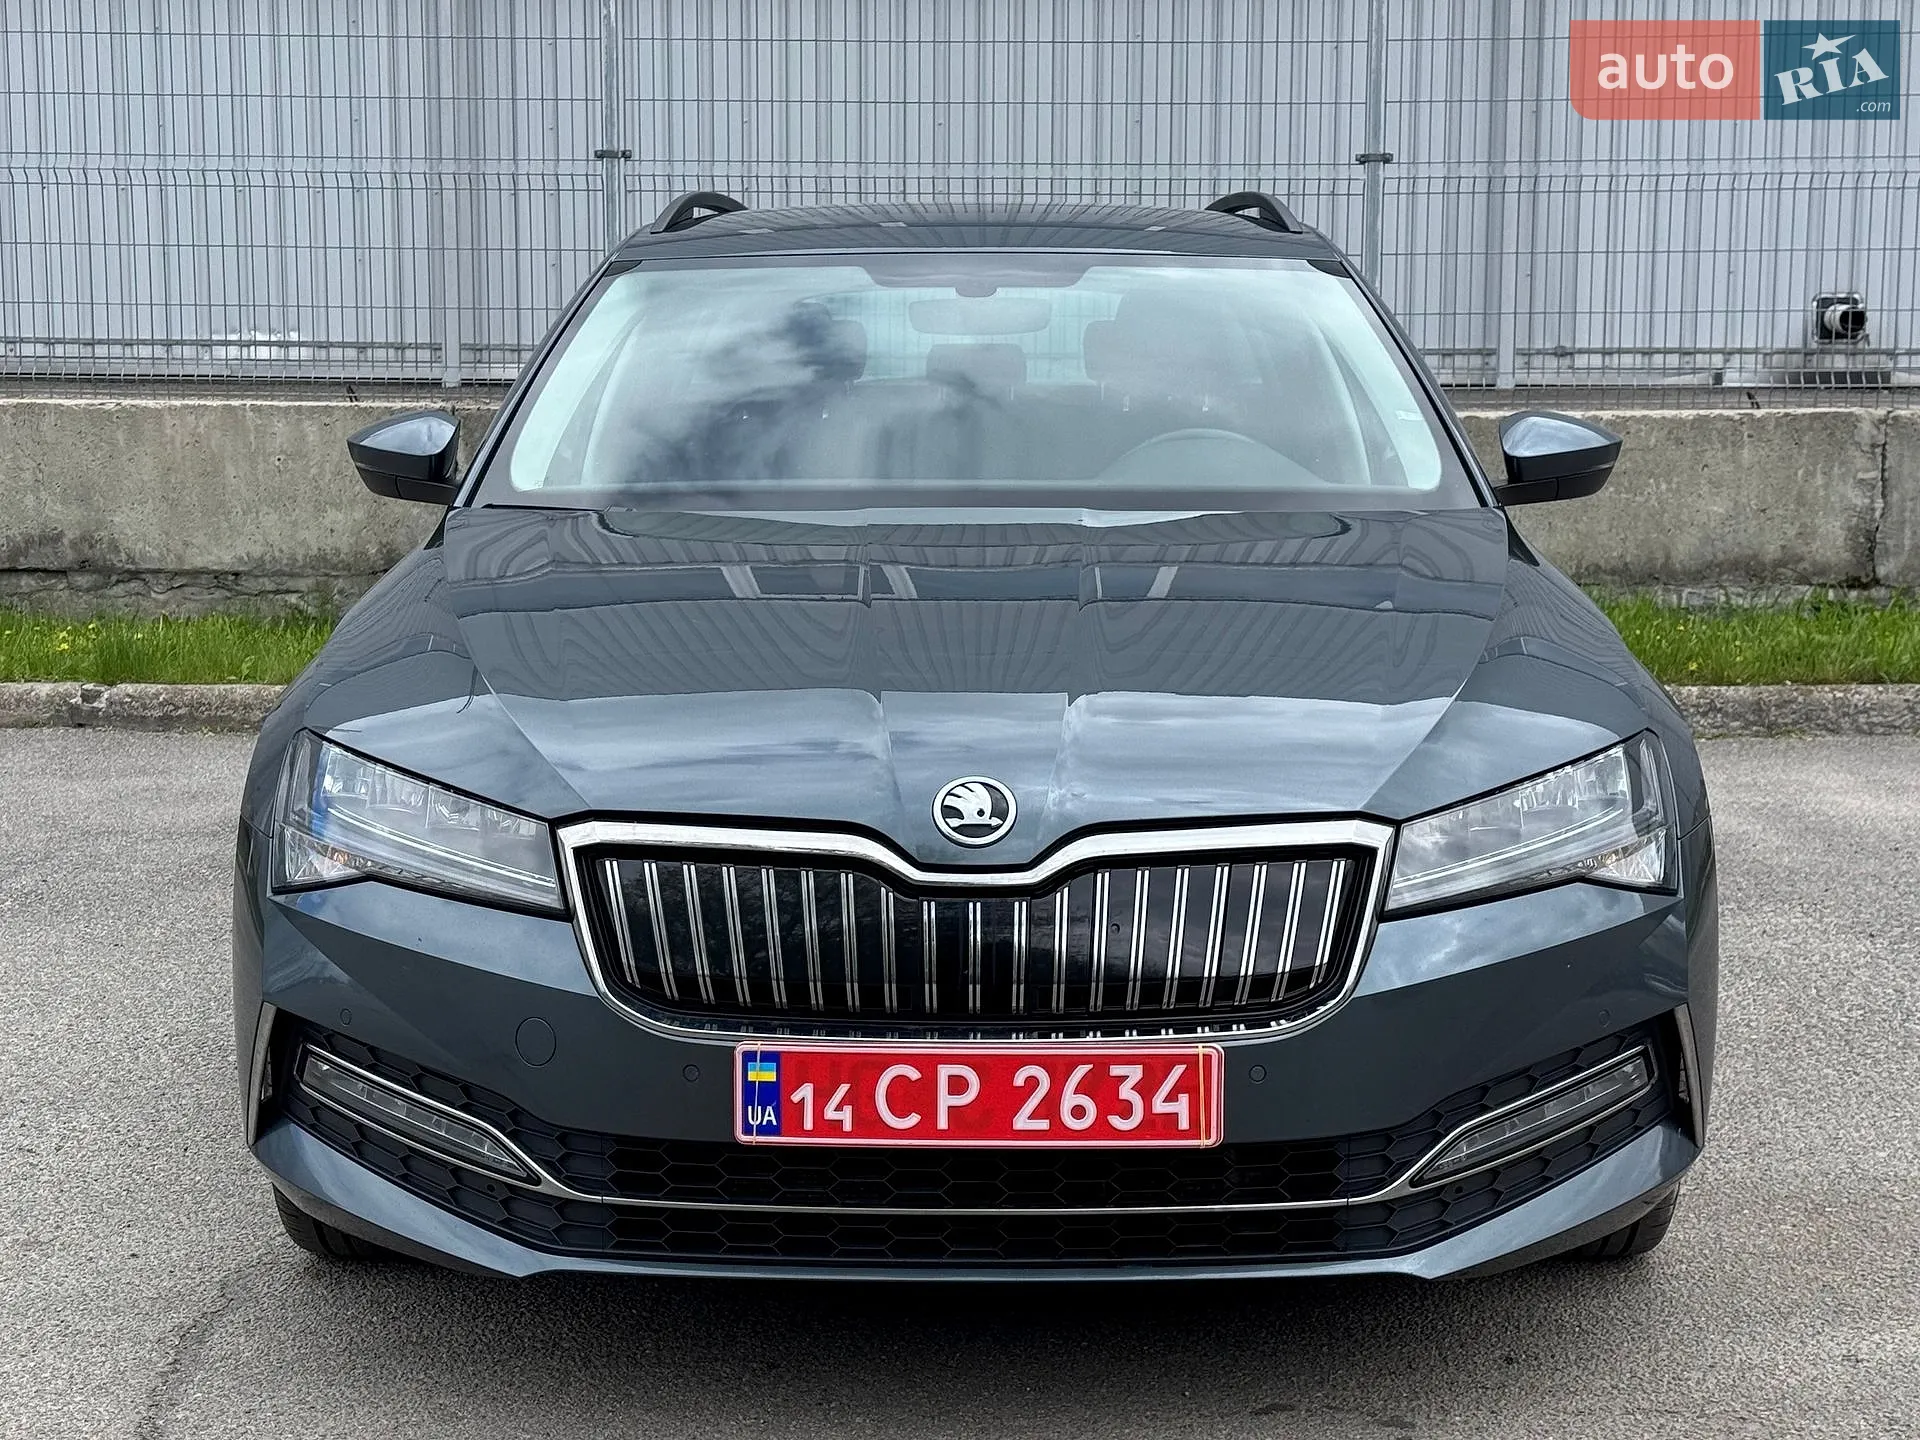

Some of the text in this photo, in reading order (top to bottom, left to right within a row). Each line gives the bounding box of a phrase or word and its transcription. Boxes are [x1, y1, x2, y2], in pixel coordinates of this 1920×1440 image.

[748, 1106, 777, 1126] UA
[790, 1064, 1190, 1131] 14 CP 2634
